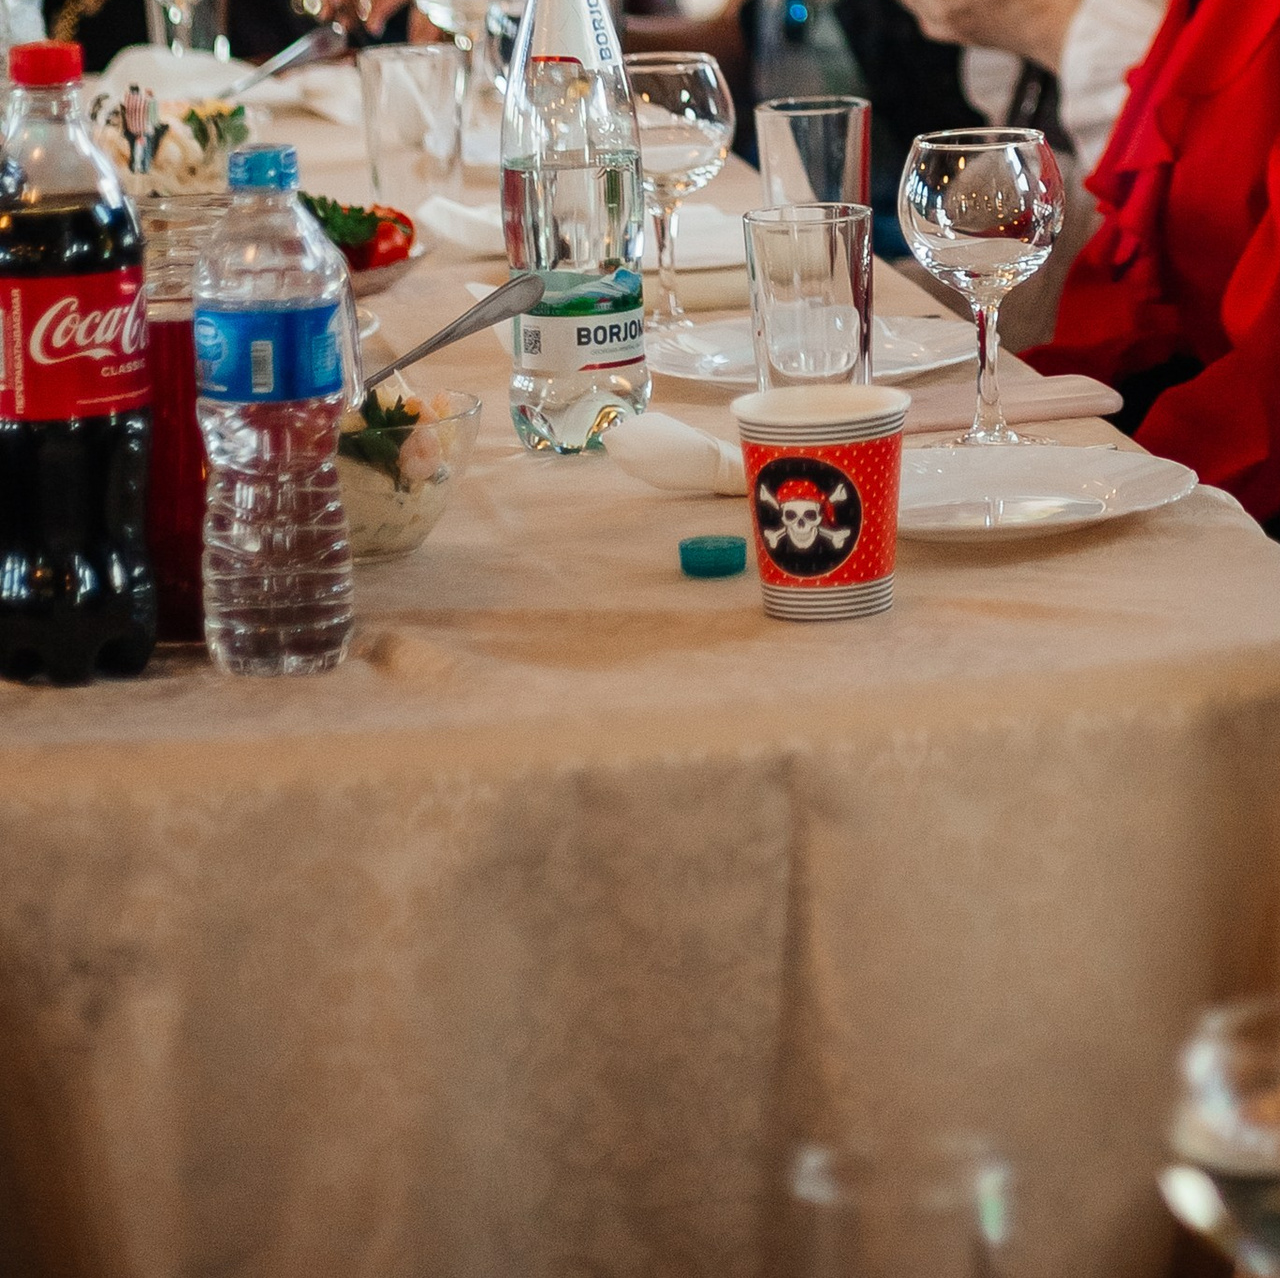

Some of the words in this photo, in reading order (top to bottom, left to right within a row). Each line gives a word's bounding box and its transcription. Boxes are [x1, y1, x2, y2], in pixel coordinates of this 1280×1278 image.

[29, 283, 148, 364] Coca-C
[576, 319, 643, 346] BORJO
[101, 358, 146, 378] CLASS
